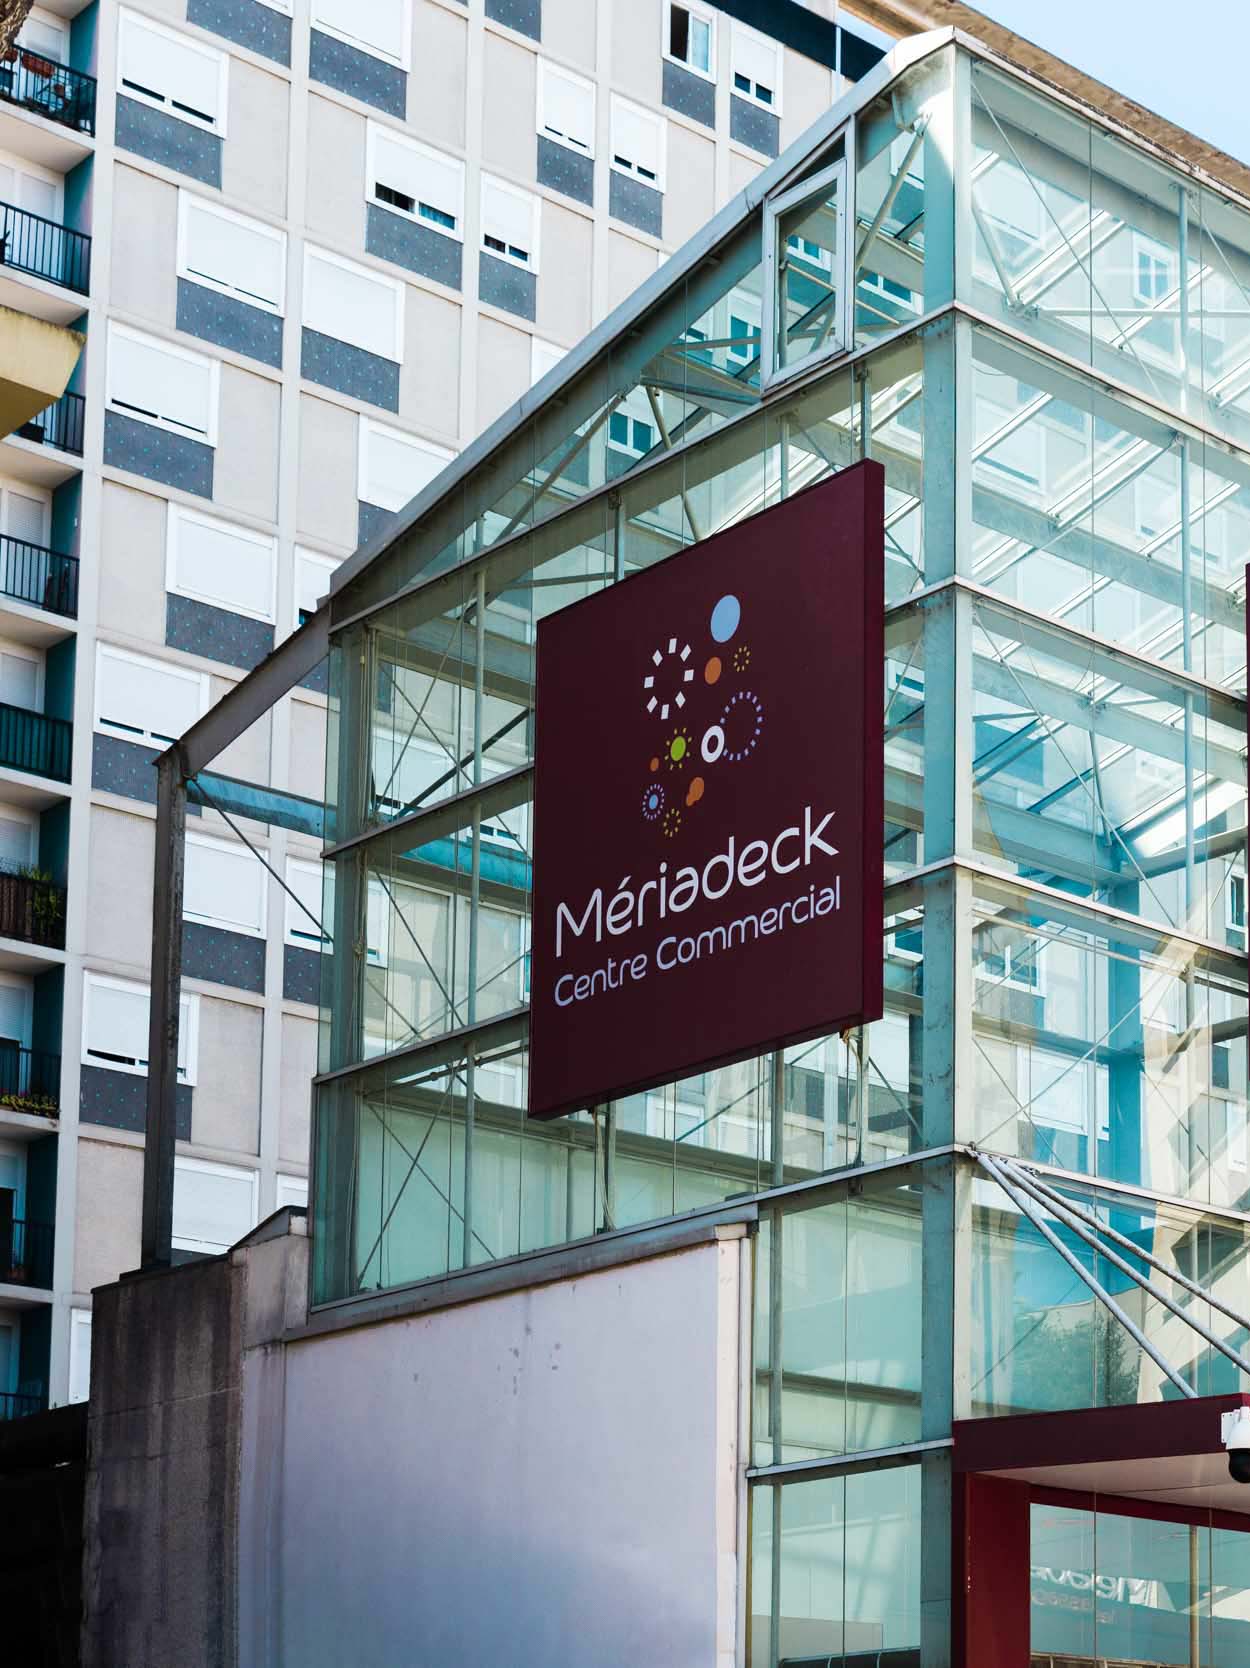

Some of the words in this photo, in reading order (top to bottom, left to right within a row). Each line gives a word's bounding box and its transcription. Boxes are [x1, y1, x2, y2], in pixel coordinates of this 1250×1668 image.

[554, 953, 648, 1007] Centre
[655, 875, 841, 970] Commercial
[555, 805, 840, 958] Mériadeck
